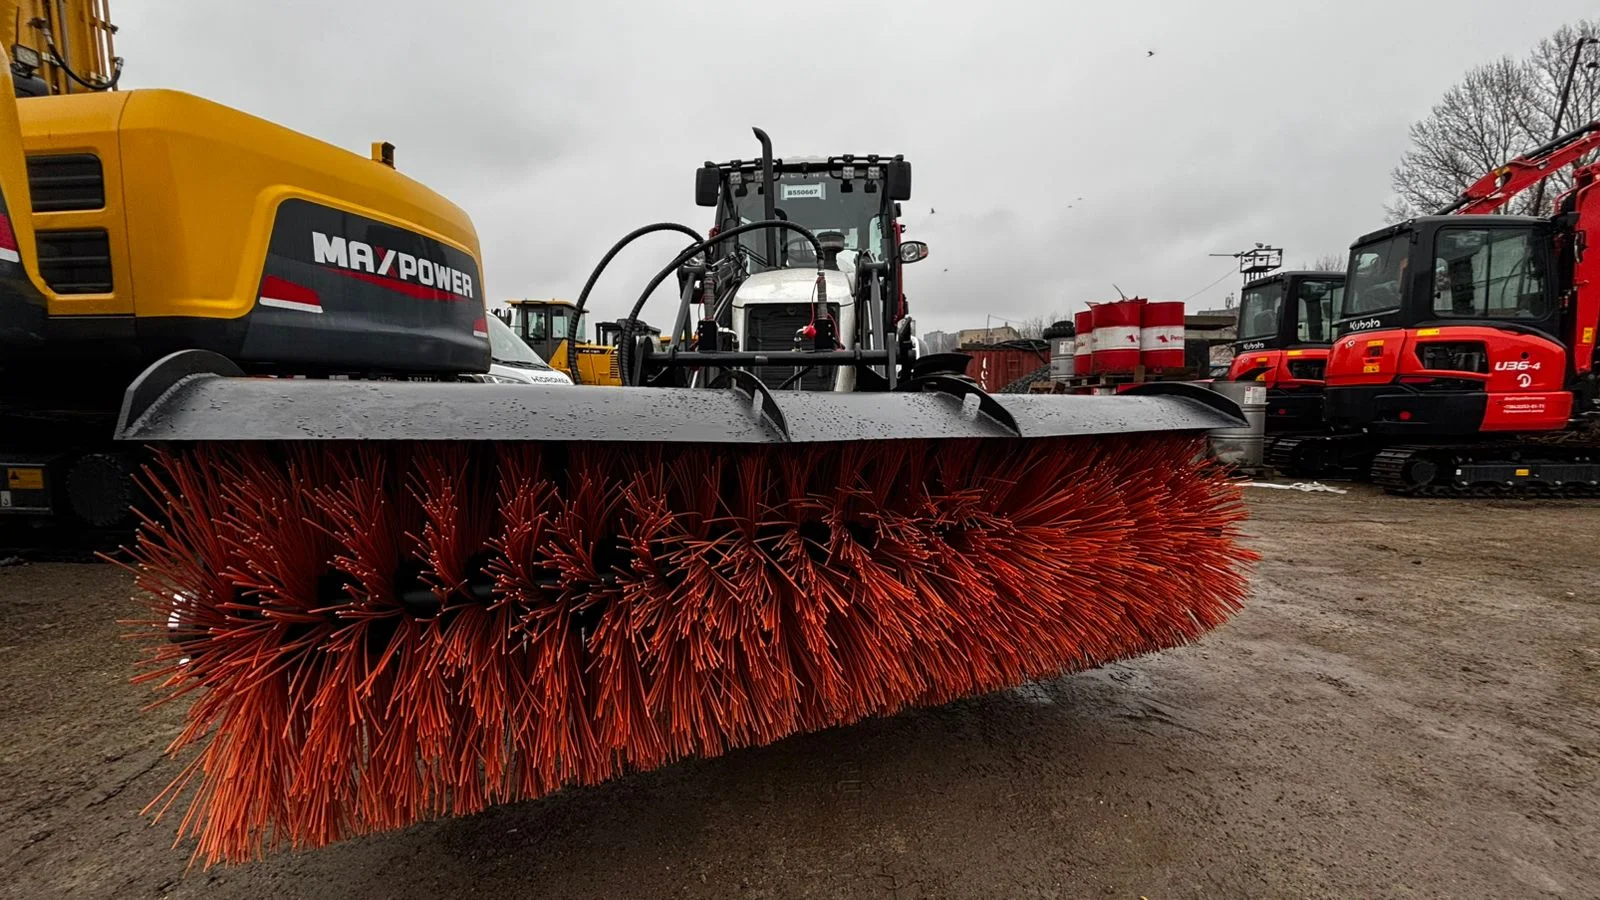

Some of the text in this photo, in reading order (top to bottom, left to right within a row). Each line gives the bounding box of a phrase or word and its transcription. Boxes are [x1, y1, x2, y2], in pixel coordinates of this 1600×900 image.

[312, 231, 473, 298] MAXPOWER
[1350, 318, 1381, 330] Kubota
[1243, 341, 1265, 350] Kubota
[1494, 360, 1542, 371] U36-4
